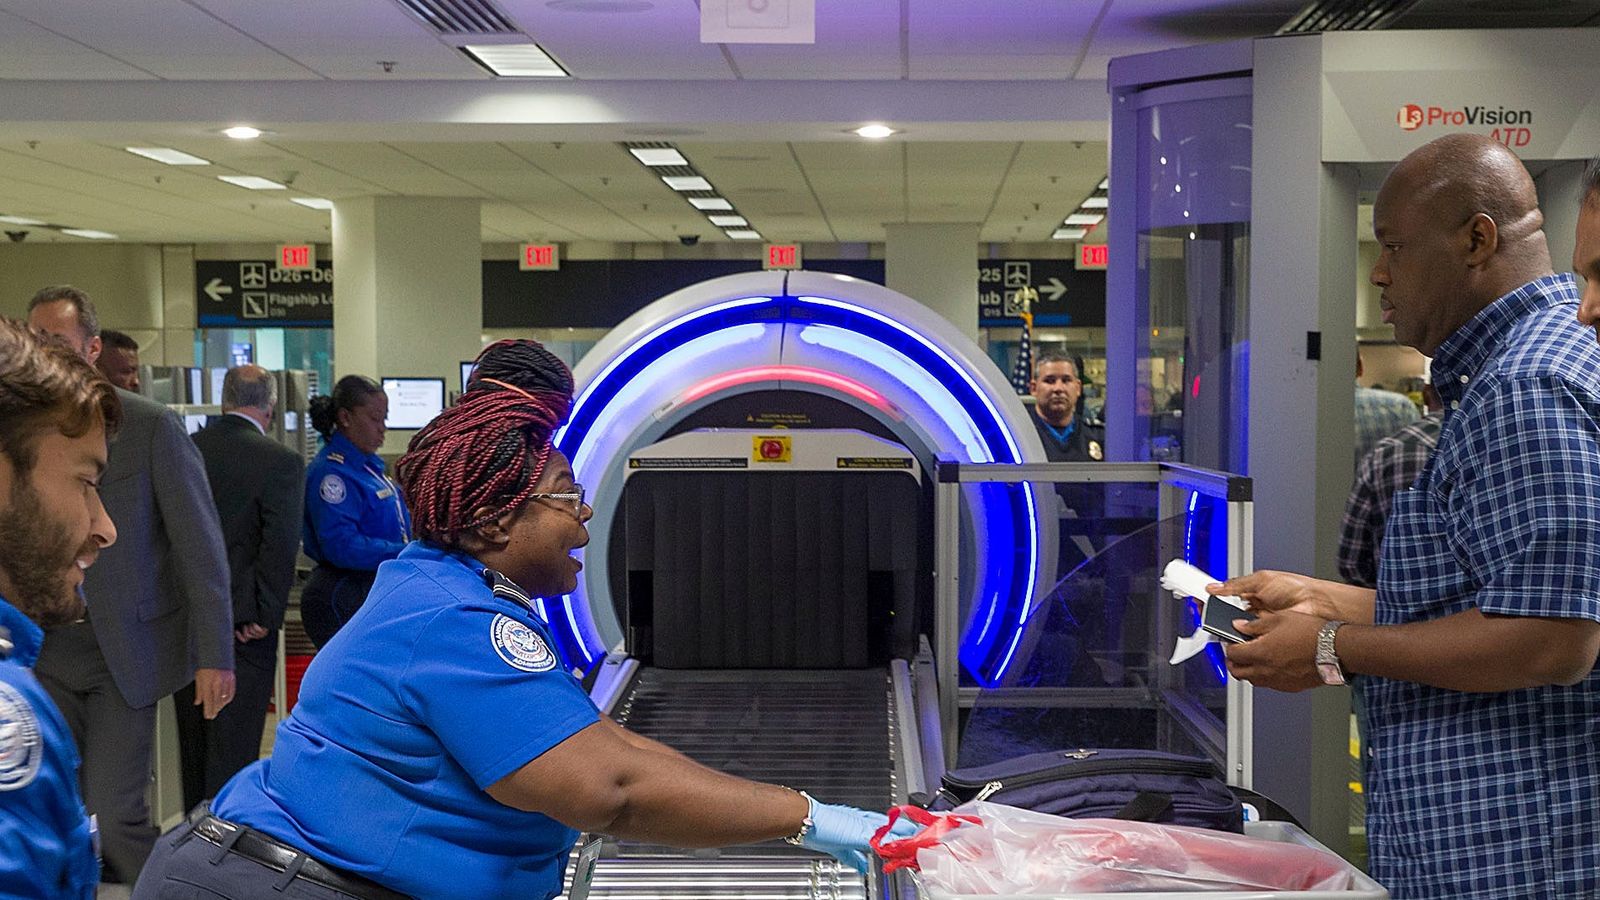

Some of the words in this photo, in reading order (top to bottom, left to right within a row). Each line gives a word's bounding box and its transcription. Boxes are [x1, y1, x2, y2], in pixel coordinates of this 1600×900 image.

[1427, 106, 1532, 125] ProVision
[283, 247, 309, 266] EXIT
[525, 246, 553, 267] EXIT
[769, 246, 796, 267] EXIT
[978, 268, 1002, 283] 25
[270, 293, 319, 307] Flagship
